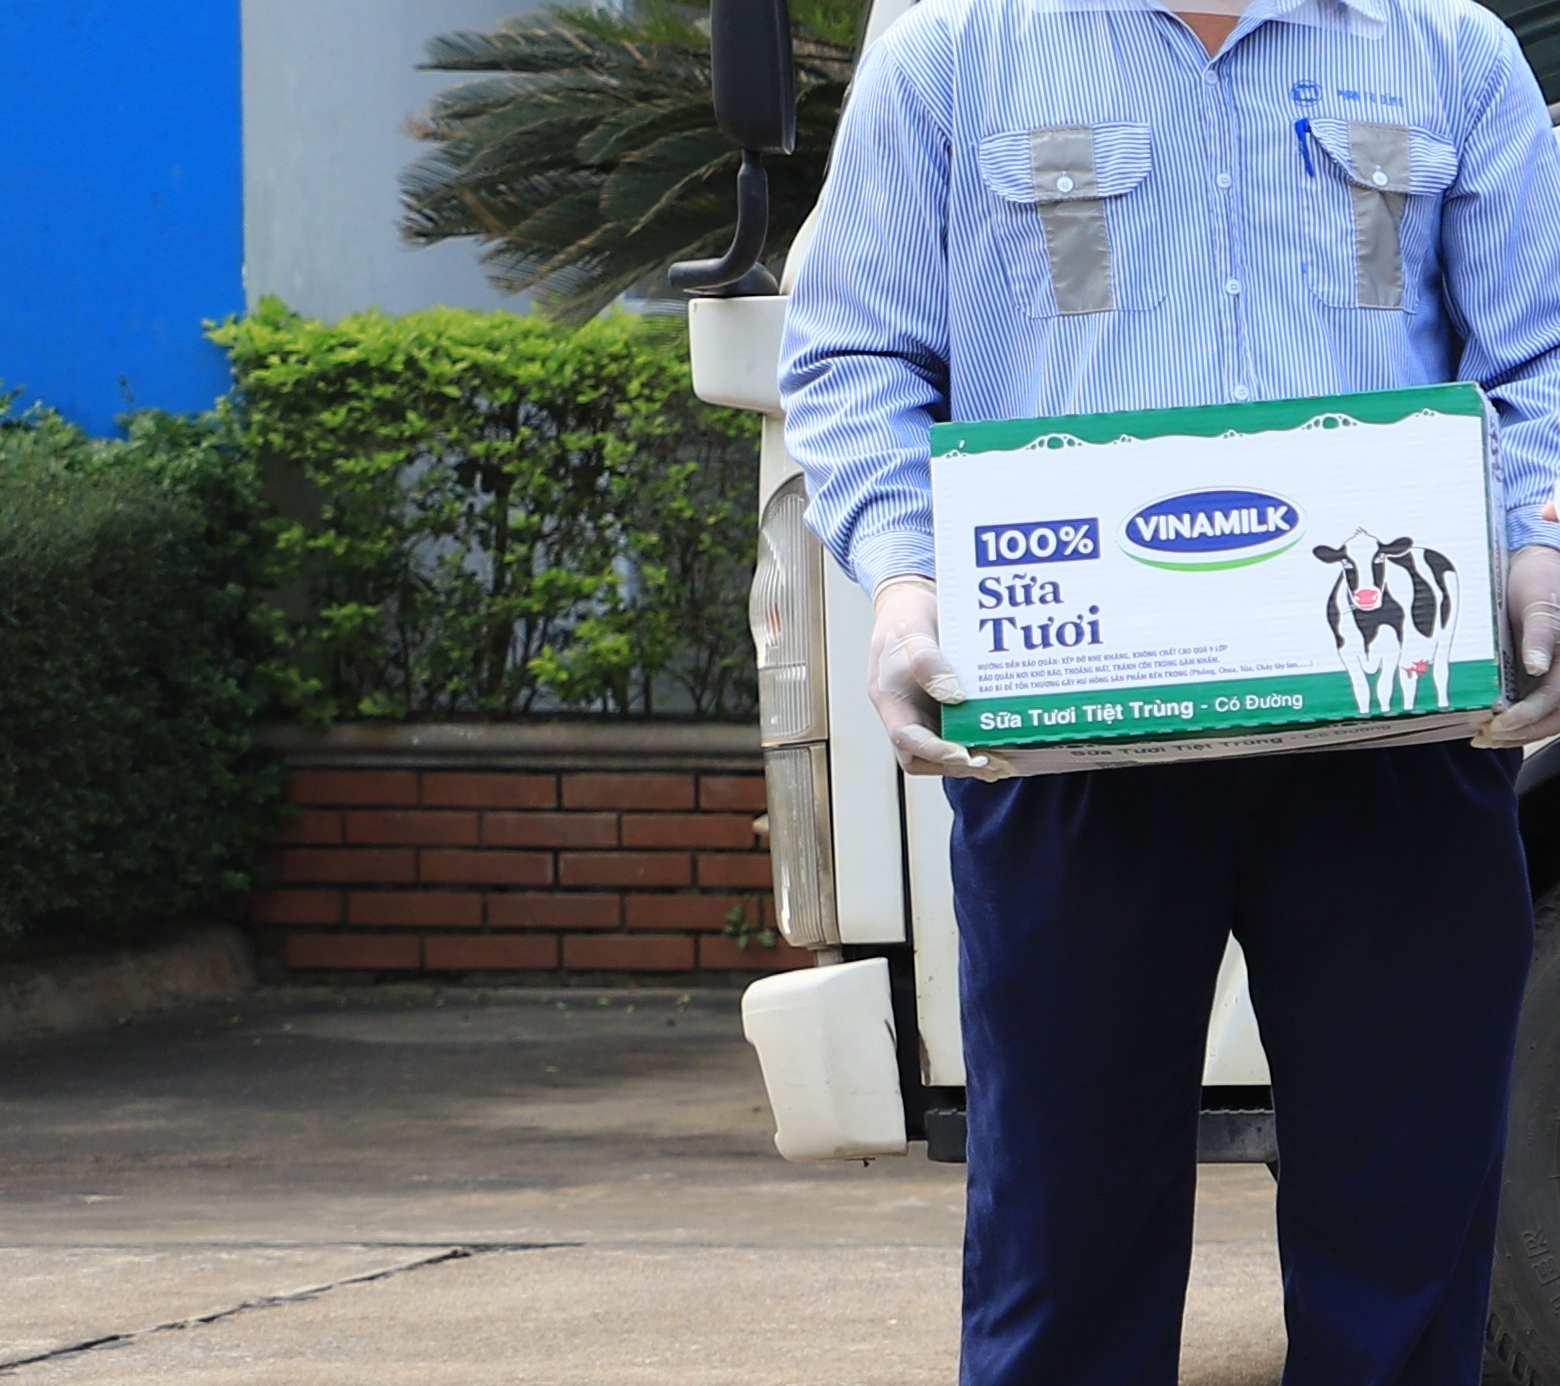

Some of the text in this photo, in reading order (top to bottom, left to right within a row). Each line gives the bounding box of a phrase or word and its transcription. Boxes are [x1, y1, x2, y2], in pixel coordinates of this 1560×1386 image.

[981, 506, 1290, 560] 100% VINAMILK
[976, 570, 1064, 612] Sữa
[977, 604, 1104, 654] Tươi
[979, 710, 1022, 731] Sữa
[1028, 707, 1077, 727] Tươi
[1082, 703, 1125, 725] Tiệt
[1129, 698, 1195, 721] Trùng
[1214, 695, 1241, 713] Có
[1244, 692, 1304, 712] Đường
